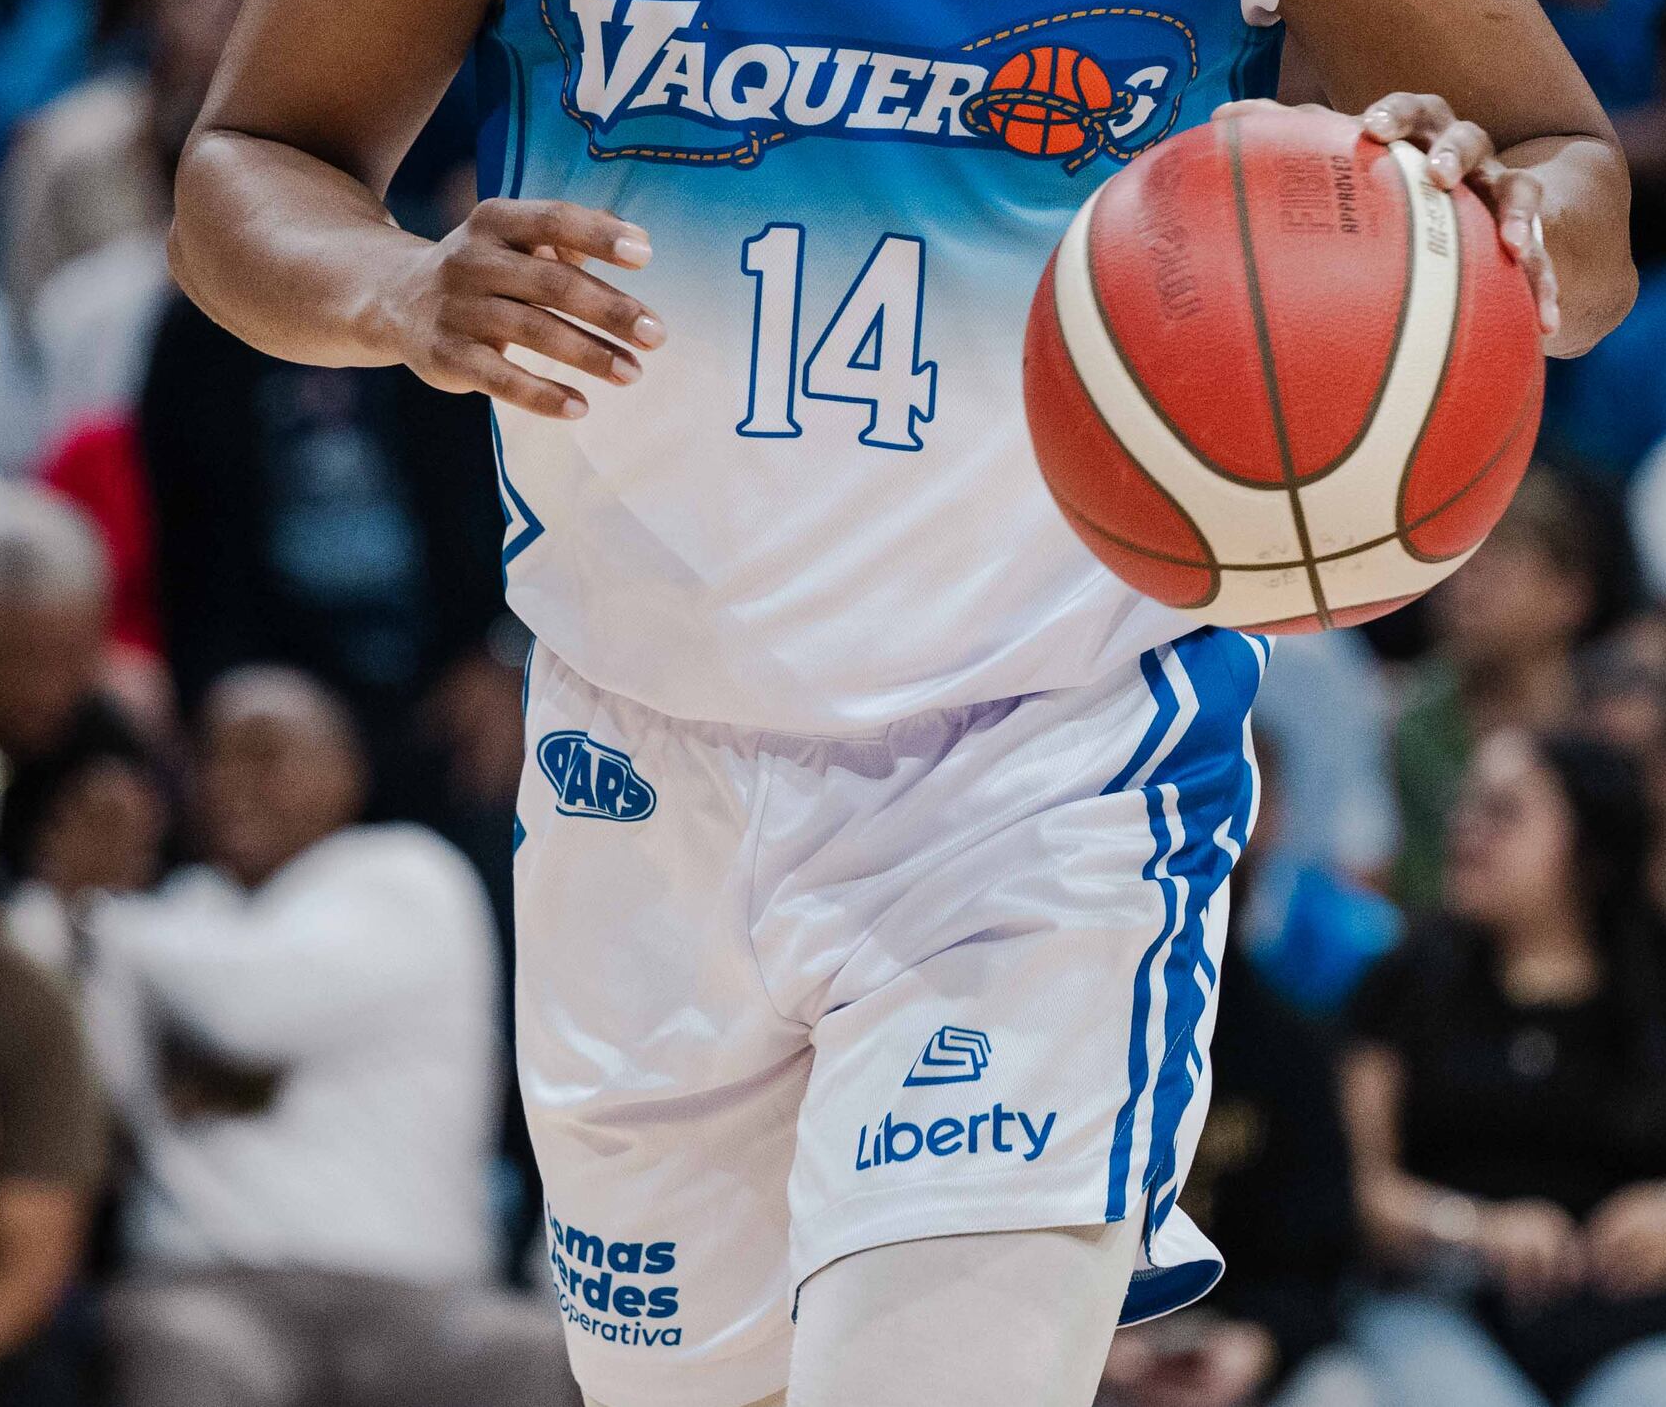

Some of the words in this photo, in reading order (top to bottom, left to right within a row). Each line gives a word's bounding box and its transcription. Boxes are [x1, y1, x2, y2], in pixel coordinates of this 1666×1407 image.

[1331, 154, 1360, 235] APPROVED
[736, 222, 938, 452] 14
[855, 1101, 1058, 1171] Liberty
